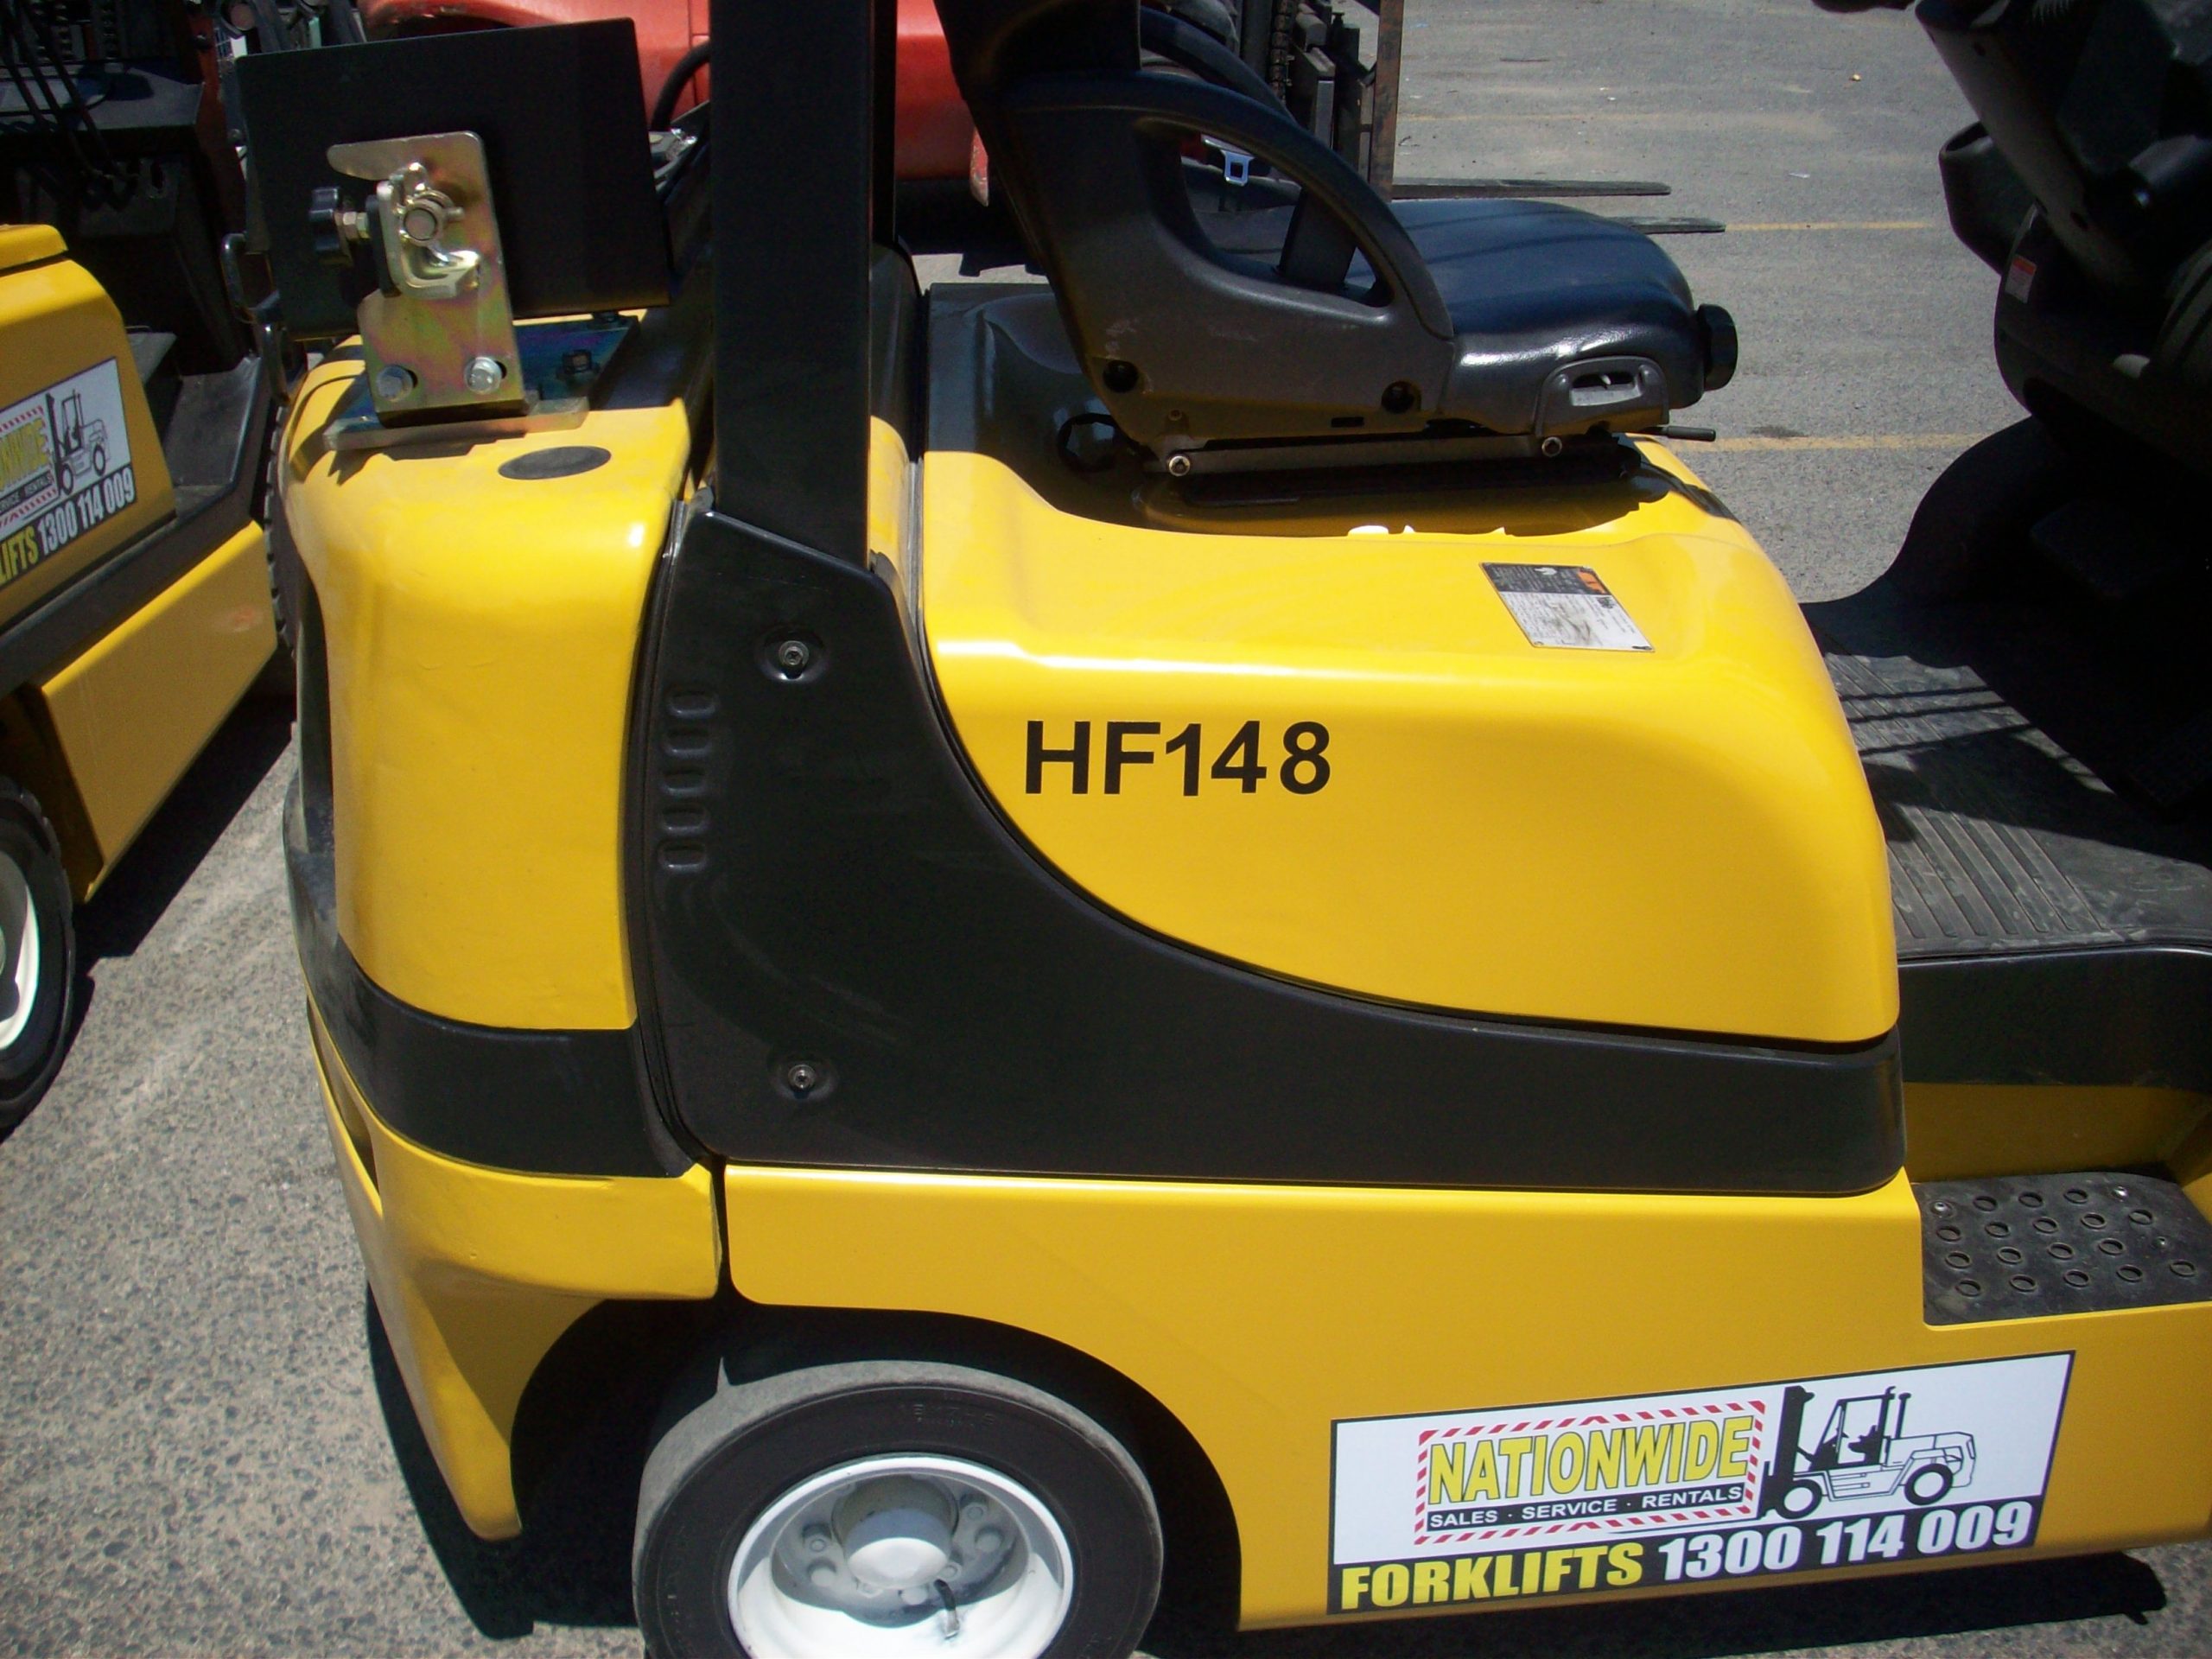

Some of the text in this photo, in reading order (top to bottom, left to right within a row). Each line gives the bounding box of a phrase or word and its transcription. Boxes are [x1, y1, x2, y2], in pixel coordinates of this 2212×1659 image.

[37, 500, 78, 556] 1300
[78, 484, 105, 530] 114
[103, 467, 136, 514] 009
[1026, 721, 1331, 796] HF148
[1428, 1415, 1754, 1505] NATIONWIDE
[1430, 1485, 1743, 1528] SALES SERVICE RENTALS
[1340, 1500, 2032, 1610] FORKLIFTS 1300 114 009
